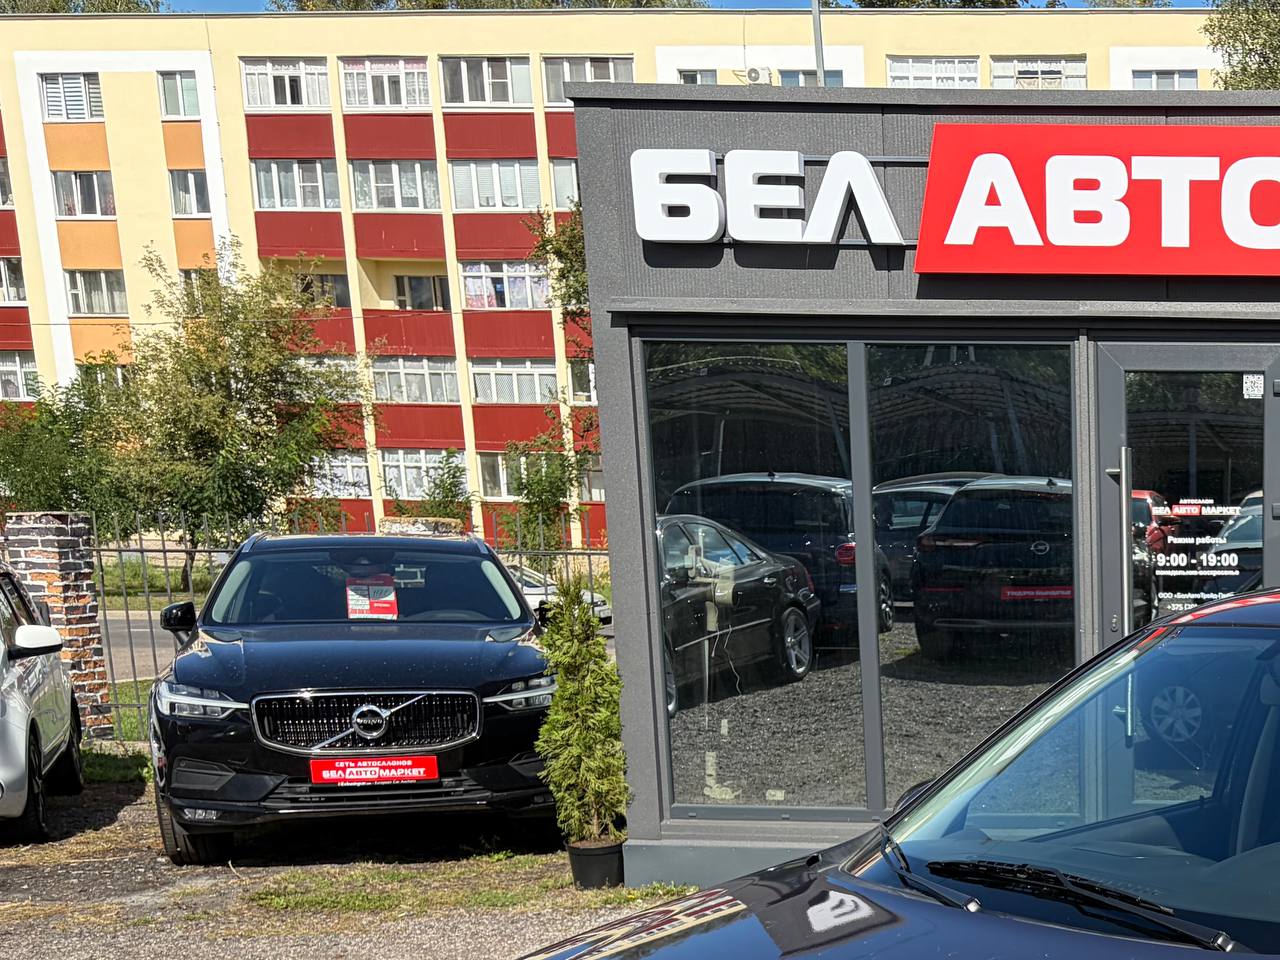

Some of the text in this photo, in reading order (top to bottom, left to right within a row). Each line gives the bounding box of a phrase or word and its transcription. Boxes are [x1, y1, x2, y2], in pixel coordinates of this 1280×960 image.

[630, 149, 906, 245] БЕЛ
[1152, 506, 1242, 516] БЕЛ АВТО МАРКЕТ
[1167, 535, 1227, 546] Режим работы
[1156, 553, 1188, 567] 9:00
[1199, 553, 1239, 567] 19:00
[1157, 591, 1174, 599] ООО
[1167, 603, 1184, 611] +375
[322, 768, 426, 779] БЕЛ АВТО МАРКЕТ
